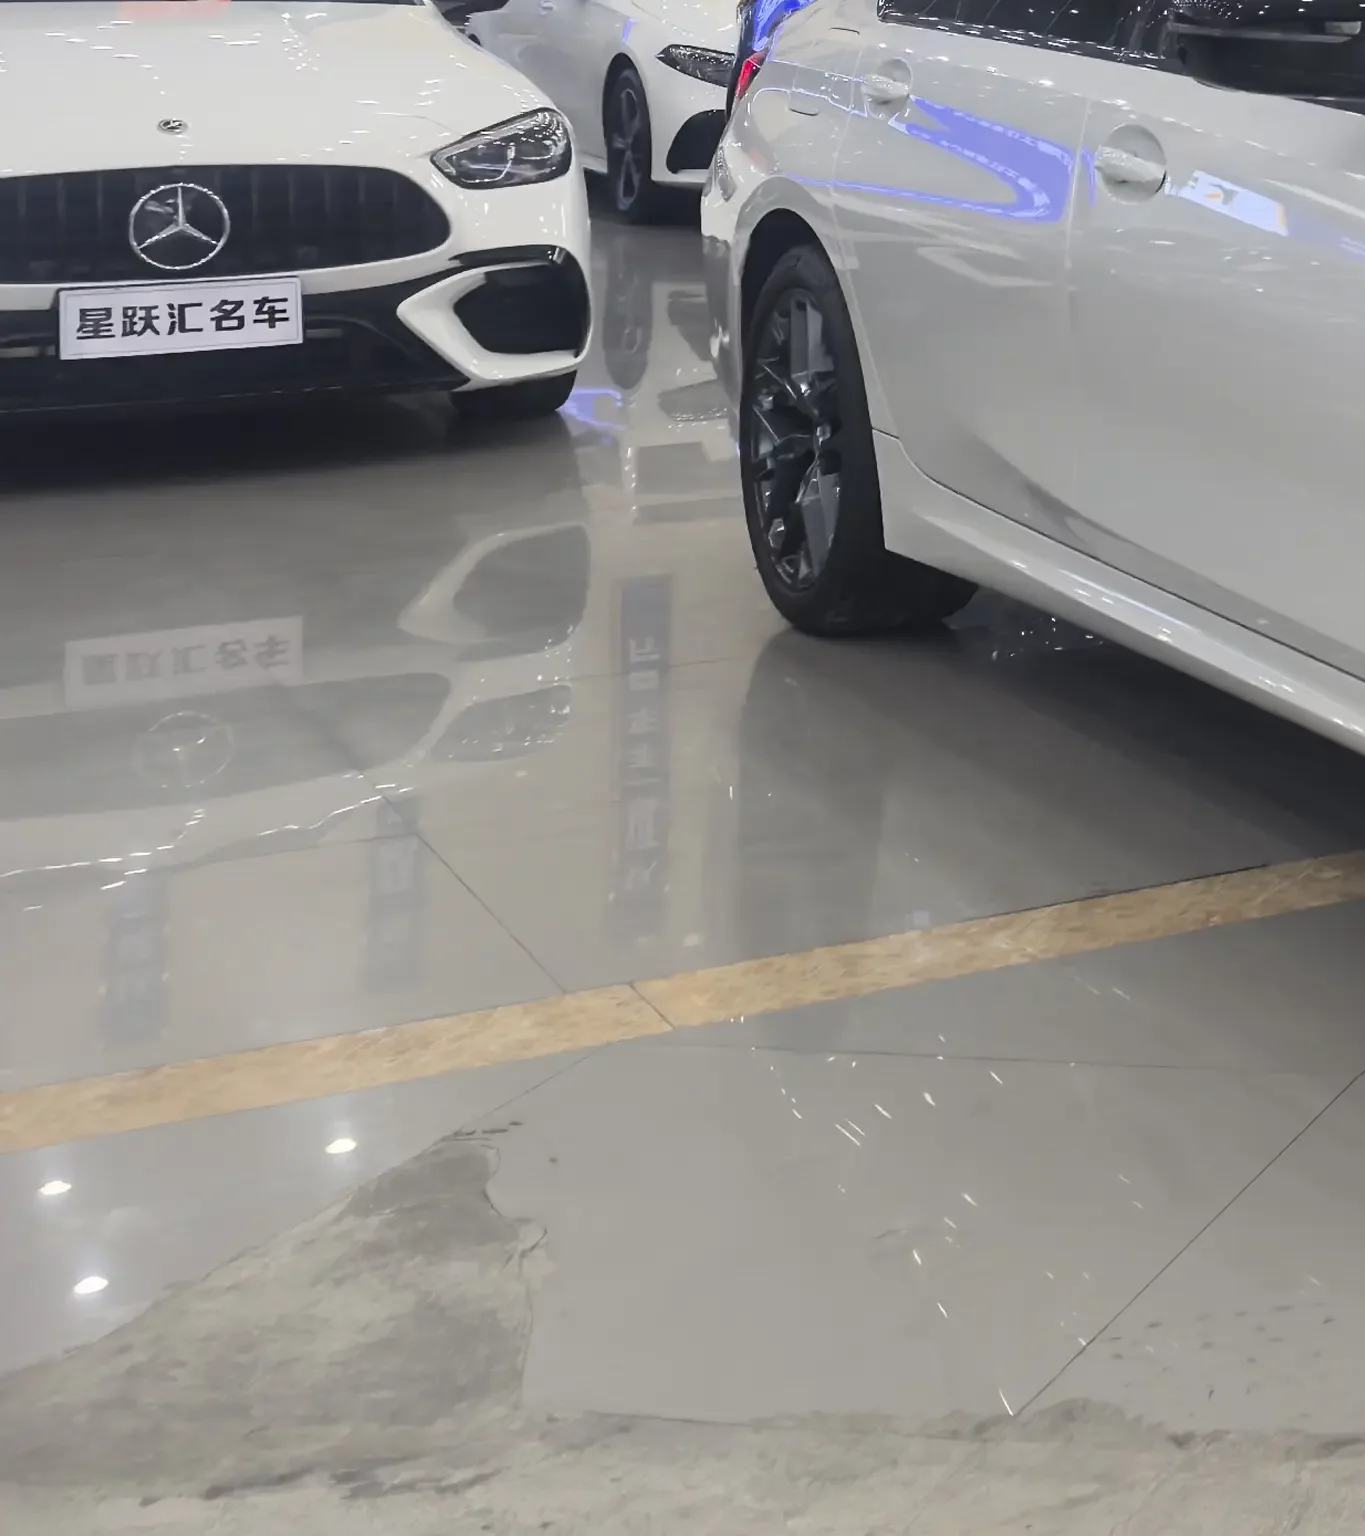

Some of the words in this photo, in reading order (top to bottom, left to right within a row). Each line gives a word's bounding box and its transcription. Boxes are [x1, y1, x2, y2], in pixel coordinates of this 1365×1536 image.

[75, 294, 291, 338] 星跃汇名车
